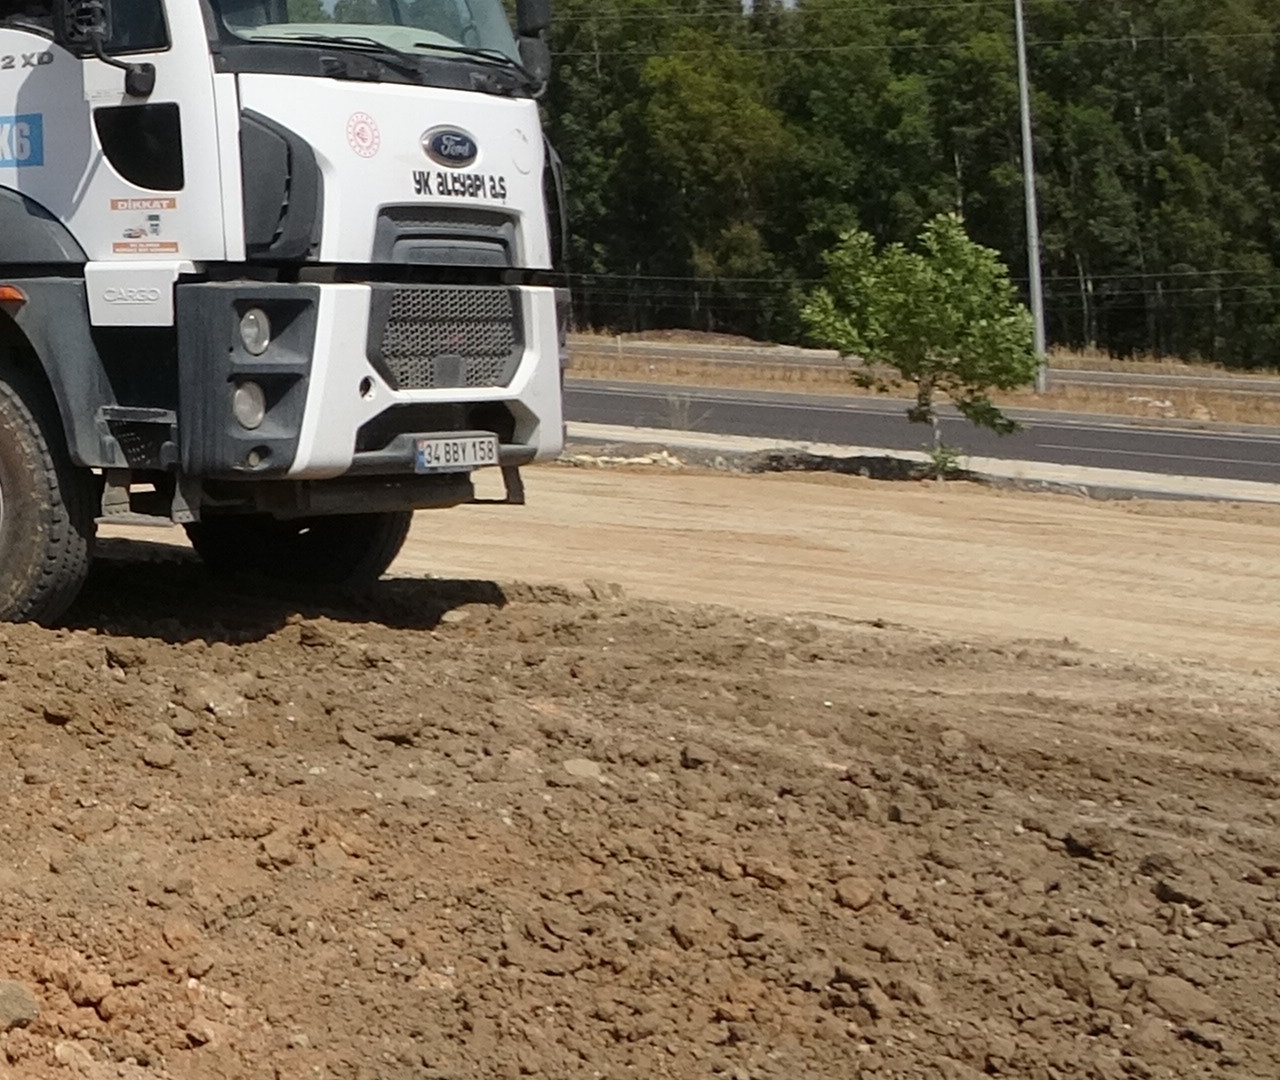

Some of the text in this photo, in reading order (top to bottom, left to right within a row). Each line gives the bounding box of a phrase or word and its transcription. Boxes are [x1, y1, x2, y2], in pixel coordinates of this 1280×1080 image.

[21, 51, 54, 68] XD
[441, 135, 470, 156] Ford
[104, 287, 160, 302] CARGO
[425, 440, 494, 464] 34 BBY 158
